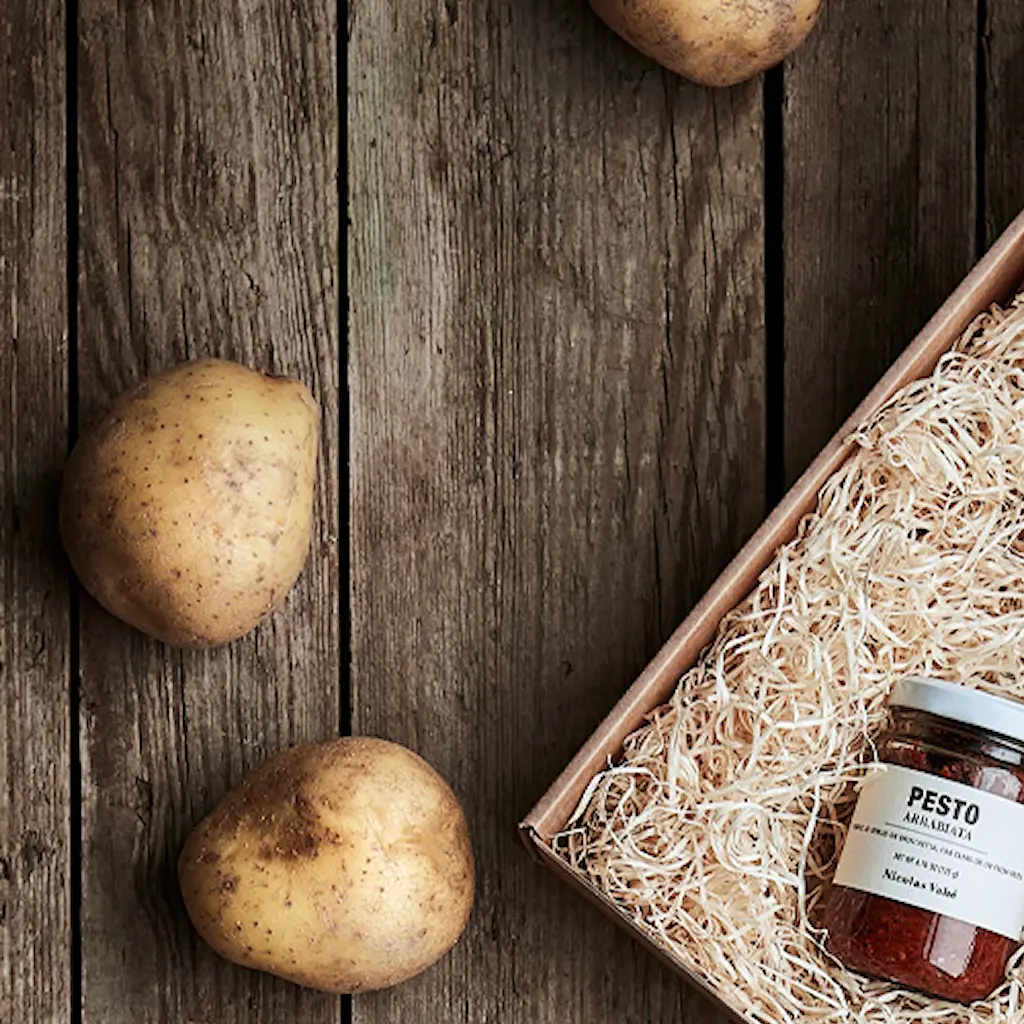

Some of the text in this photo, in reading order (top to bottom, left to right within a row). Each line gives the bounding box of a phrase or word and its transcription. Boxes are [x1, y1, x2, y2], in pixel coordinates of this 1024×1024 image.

[907, 786, 980, 825] PESTO
[903, 811, 973, 842] ARRABIATA
[882, 868, 958, 899] Nicolas Vahé
